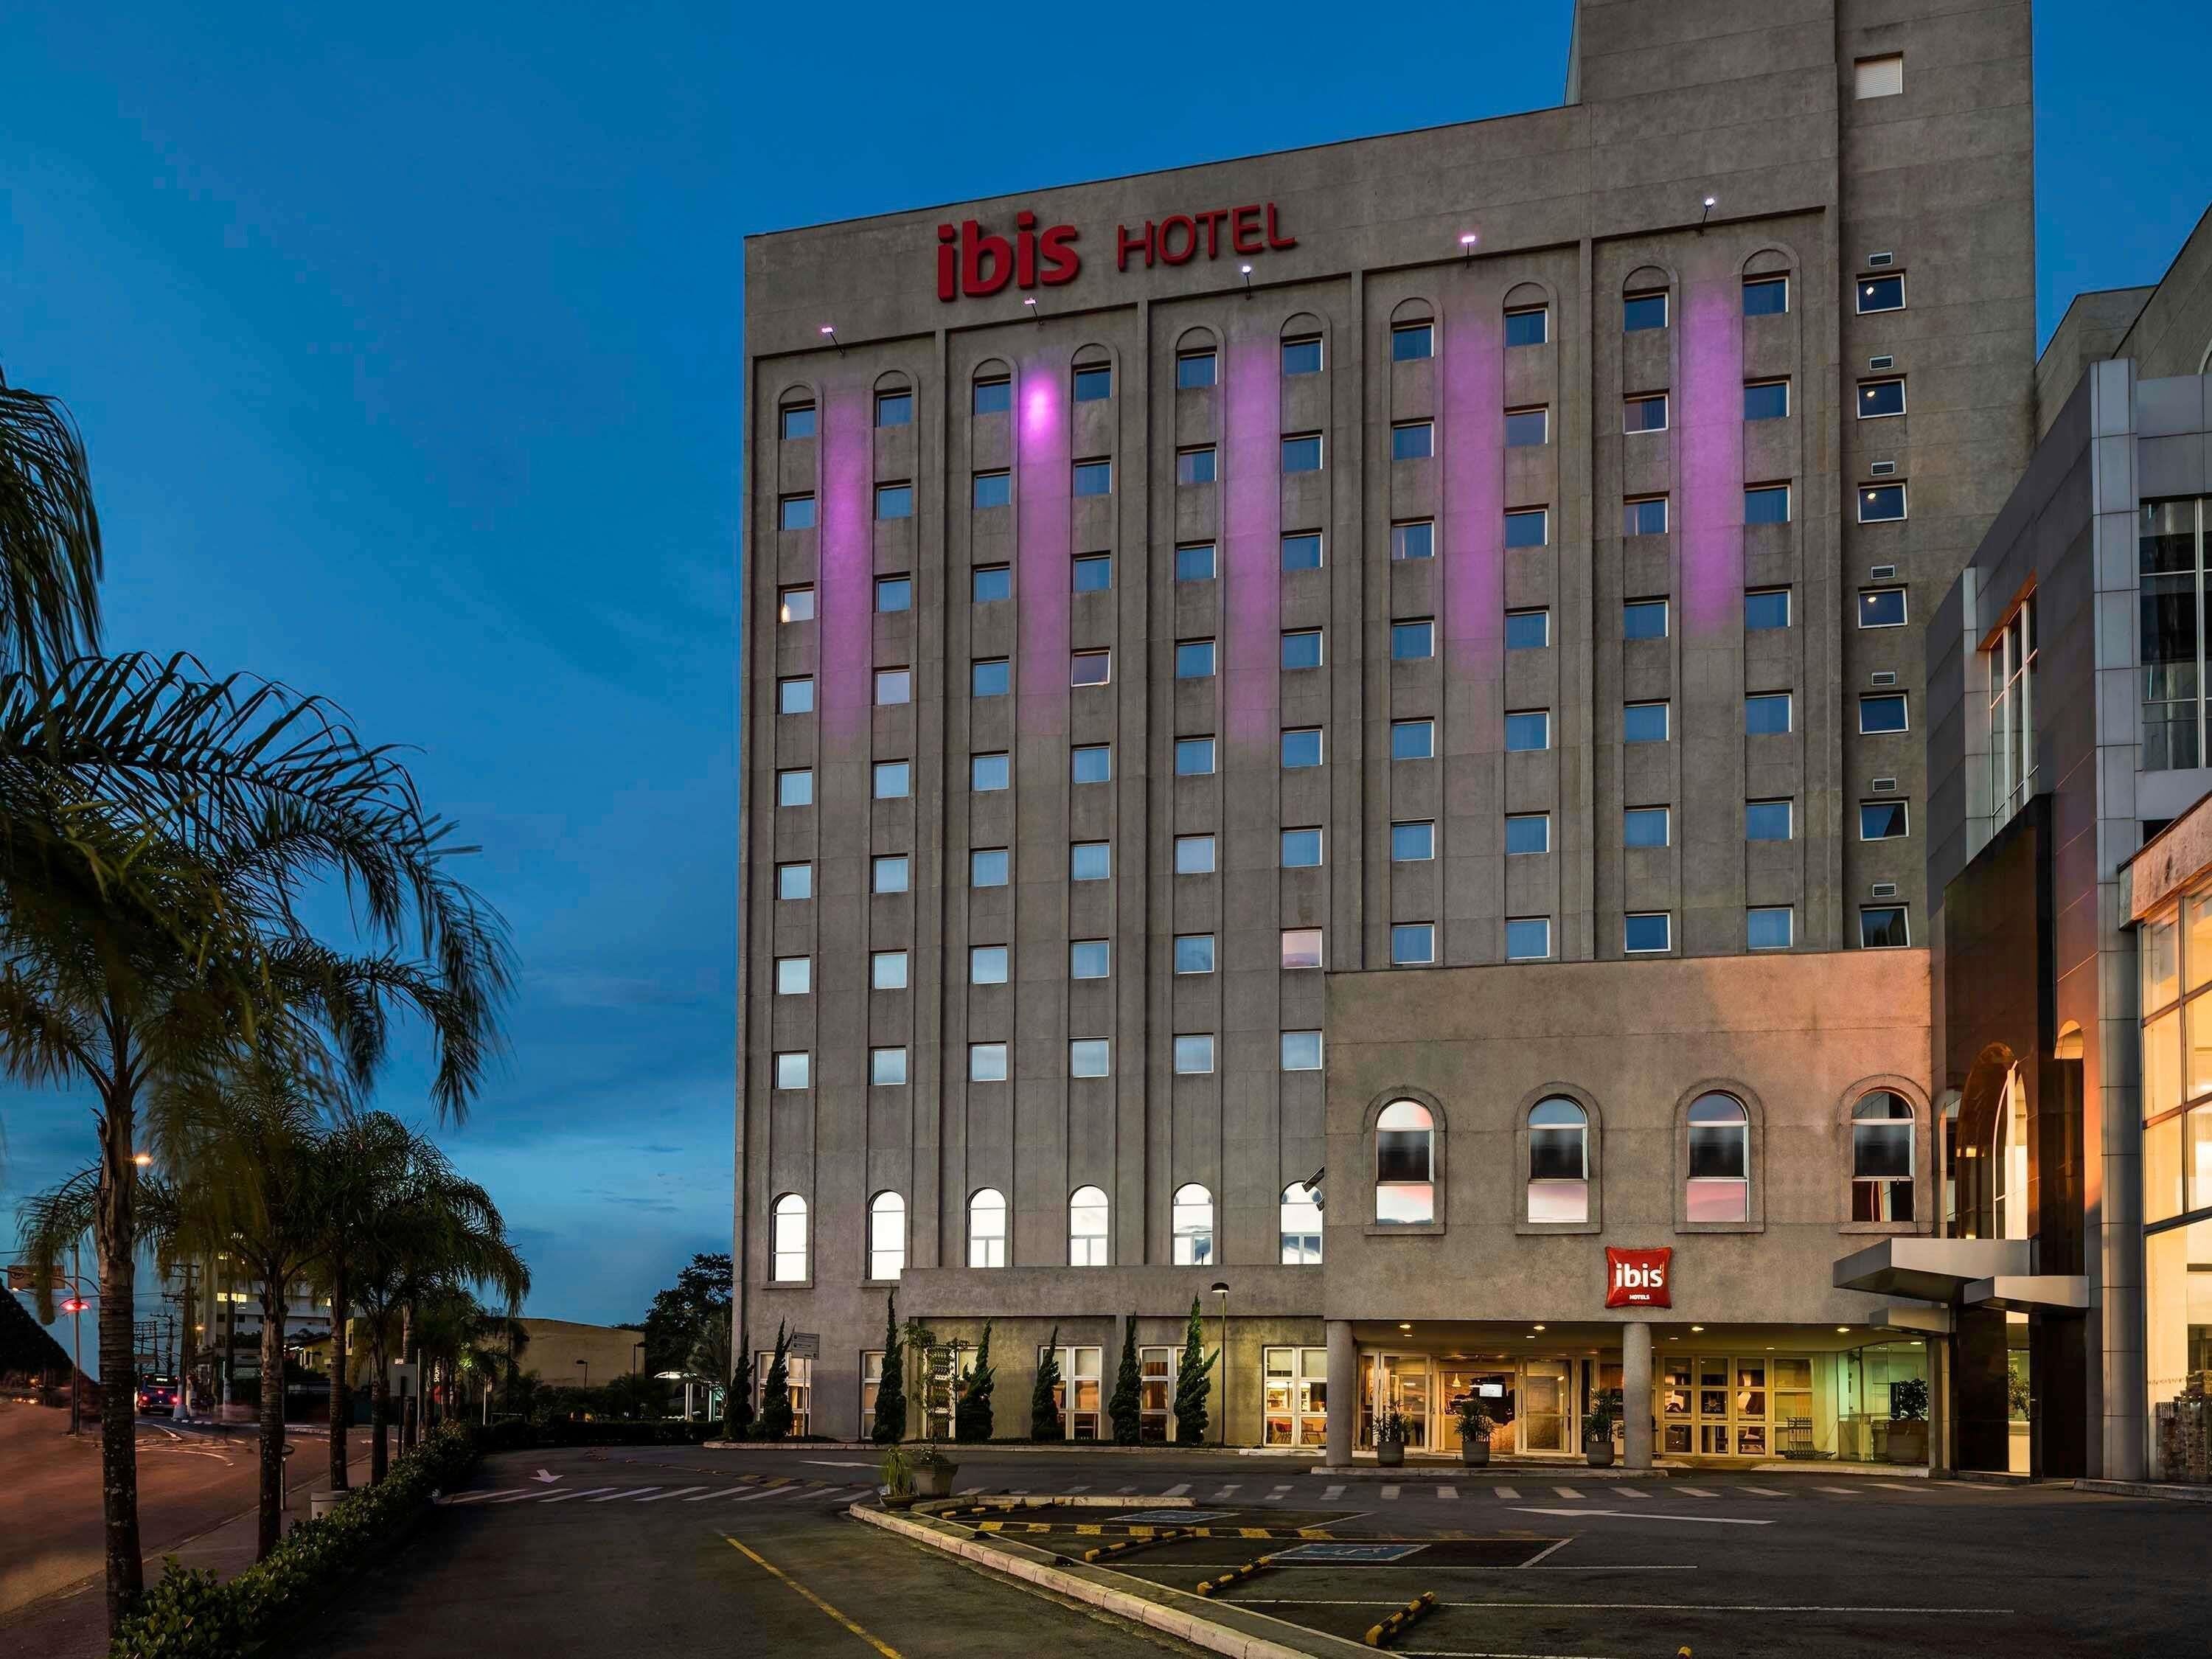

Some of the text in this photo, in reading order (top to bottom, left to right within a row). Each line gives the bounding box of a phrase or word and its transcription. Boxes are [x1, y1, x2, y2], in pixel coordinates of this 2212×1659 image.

[937, 202, 1297, 302] ibis HOTEL
[1616, 1263, 1663, 1287] ibis
